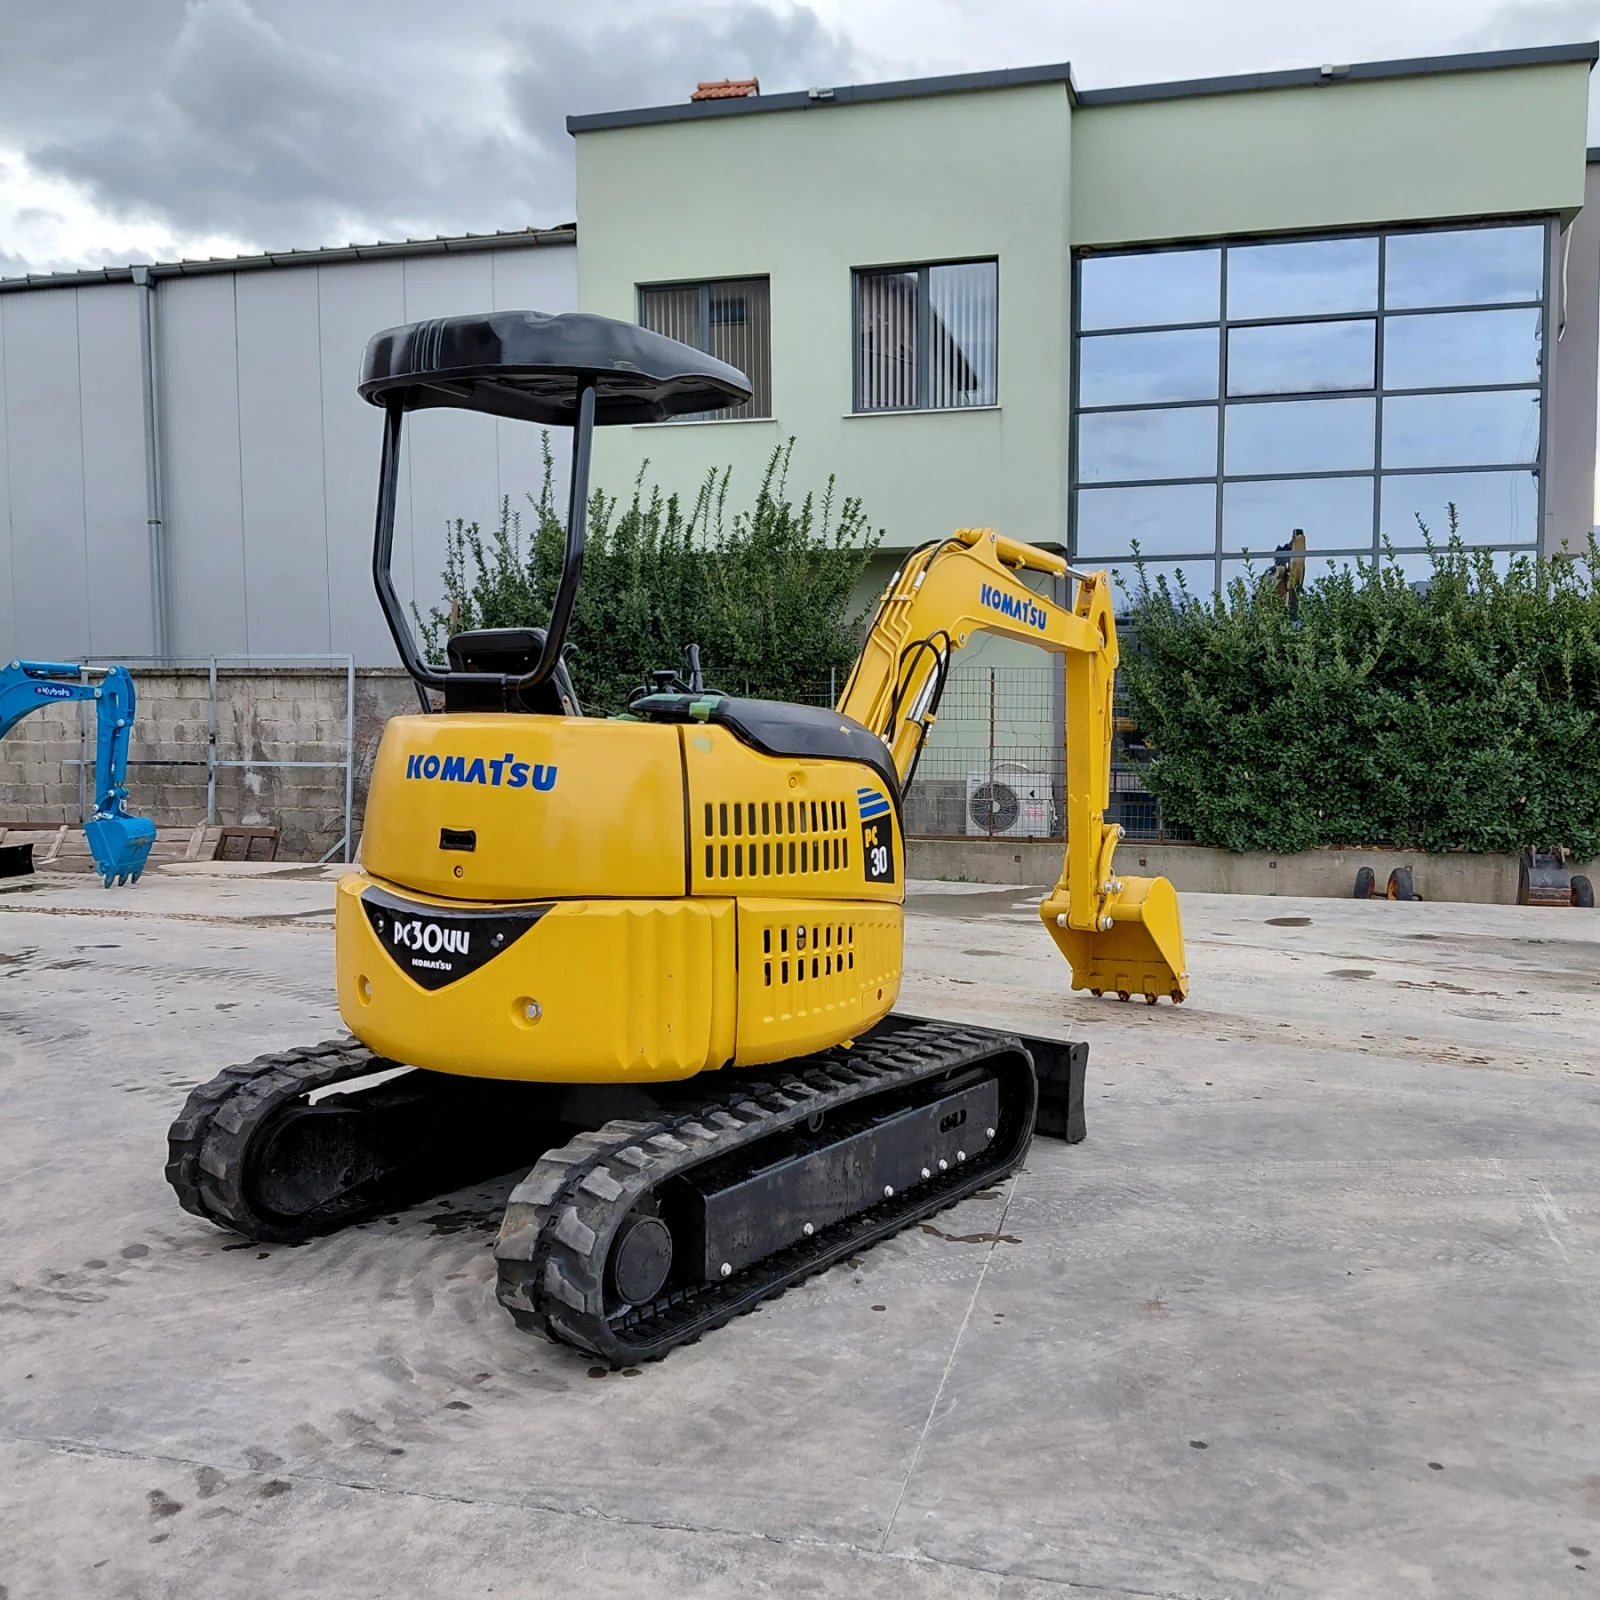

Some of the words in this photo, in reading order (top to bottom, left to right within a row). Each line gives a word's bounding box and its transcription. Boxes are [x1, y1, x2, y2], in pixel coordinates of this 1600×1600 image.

[980, 582, 1047, 631] KOMATSU
[42, 686, 70, 697] Kubota
[406, 753, 558, 792] KOMATSU
[864, 825, 878, 848] PC
[870, 845, 888, 877] 30
[393, 920, 470, 955] PC30UU
[411, 958, 452, 971] KOMATSU
